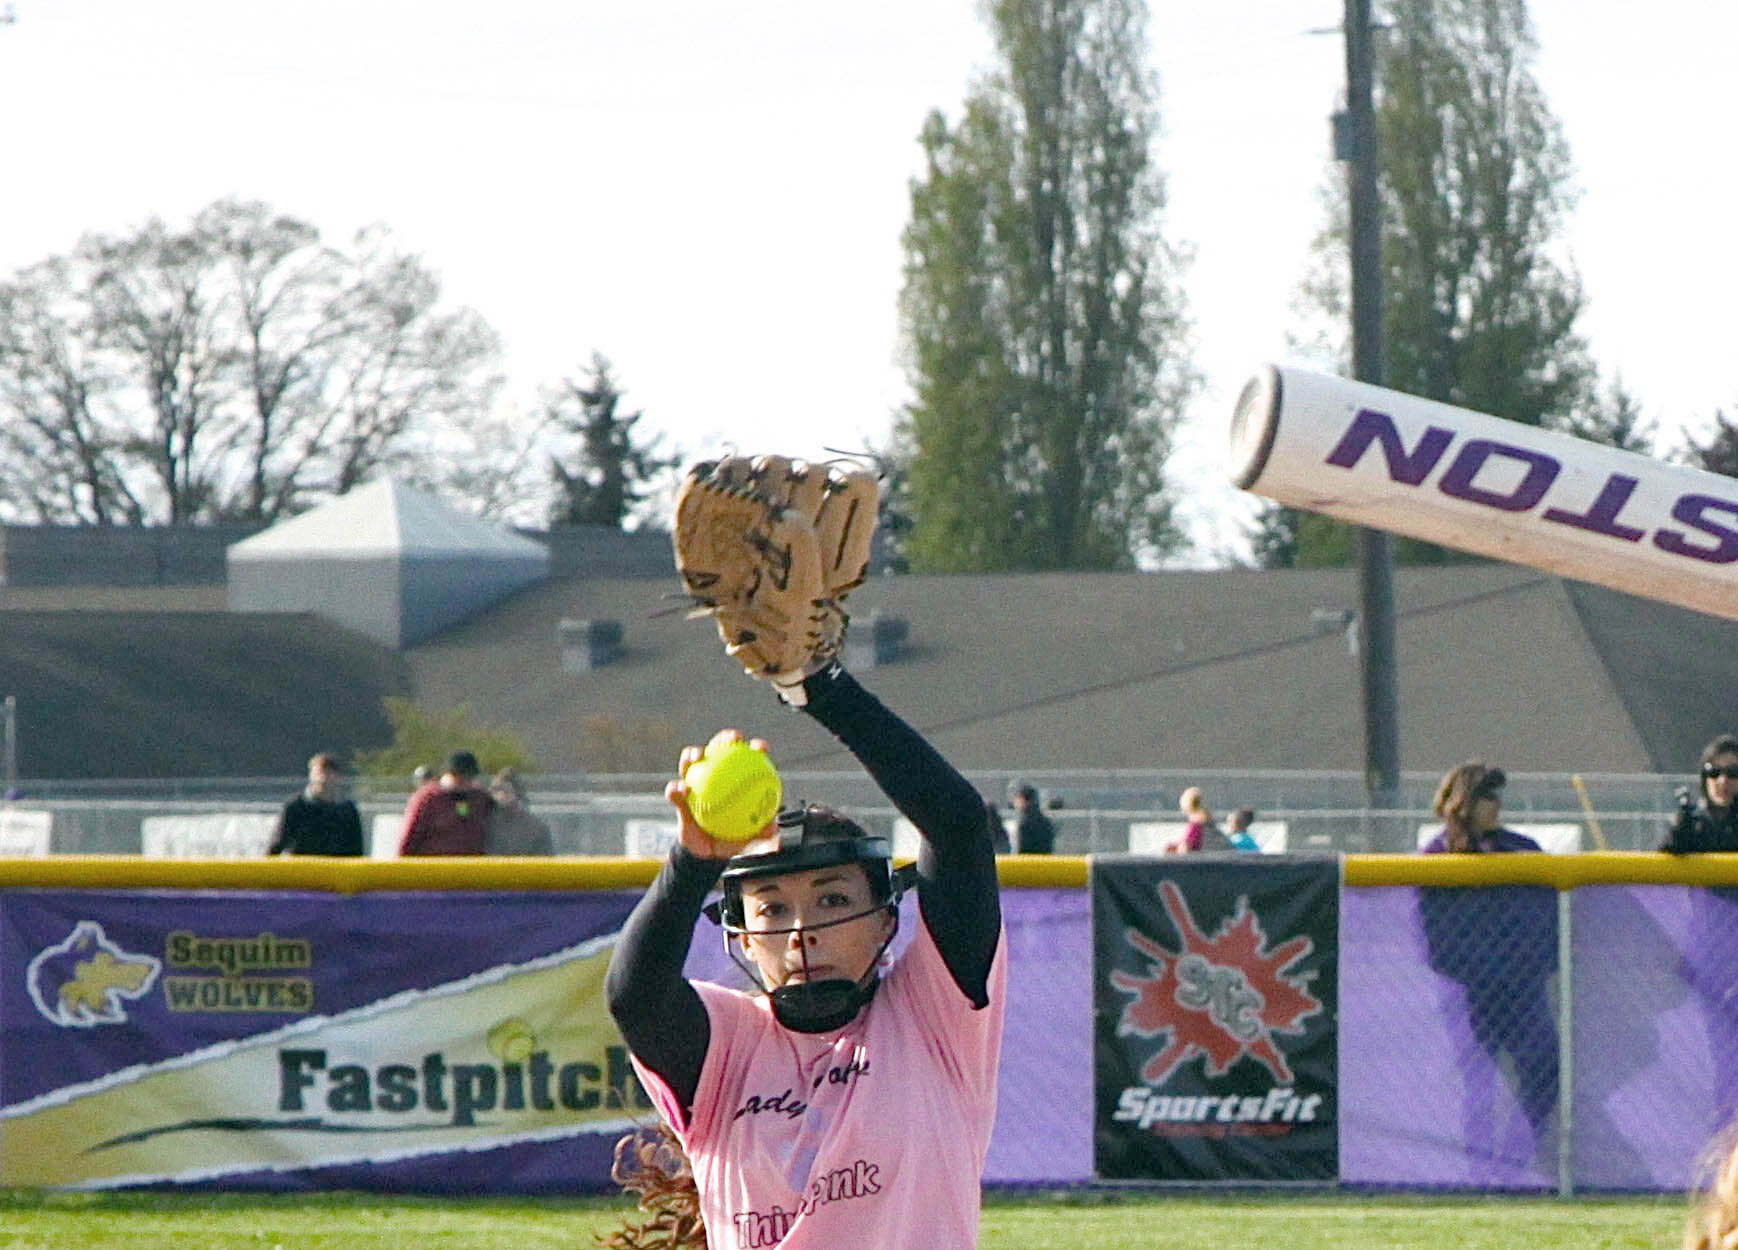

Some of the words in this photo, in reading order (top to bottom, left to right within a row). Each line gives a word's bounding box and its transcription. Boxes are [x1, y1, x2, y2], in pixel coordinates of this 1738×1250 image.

[169, 931, 310, 974] Sequim
[167, 979, 311, 1009] WOLVES
[280, 1044, 646, 1127] Fastpitch
[1112, 1086, 1323, 1129] SportsFit
[734, 1200, 804, 1249] Thi
